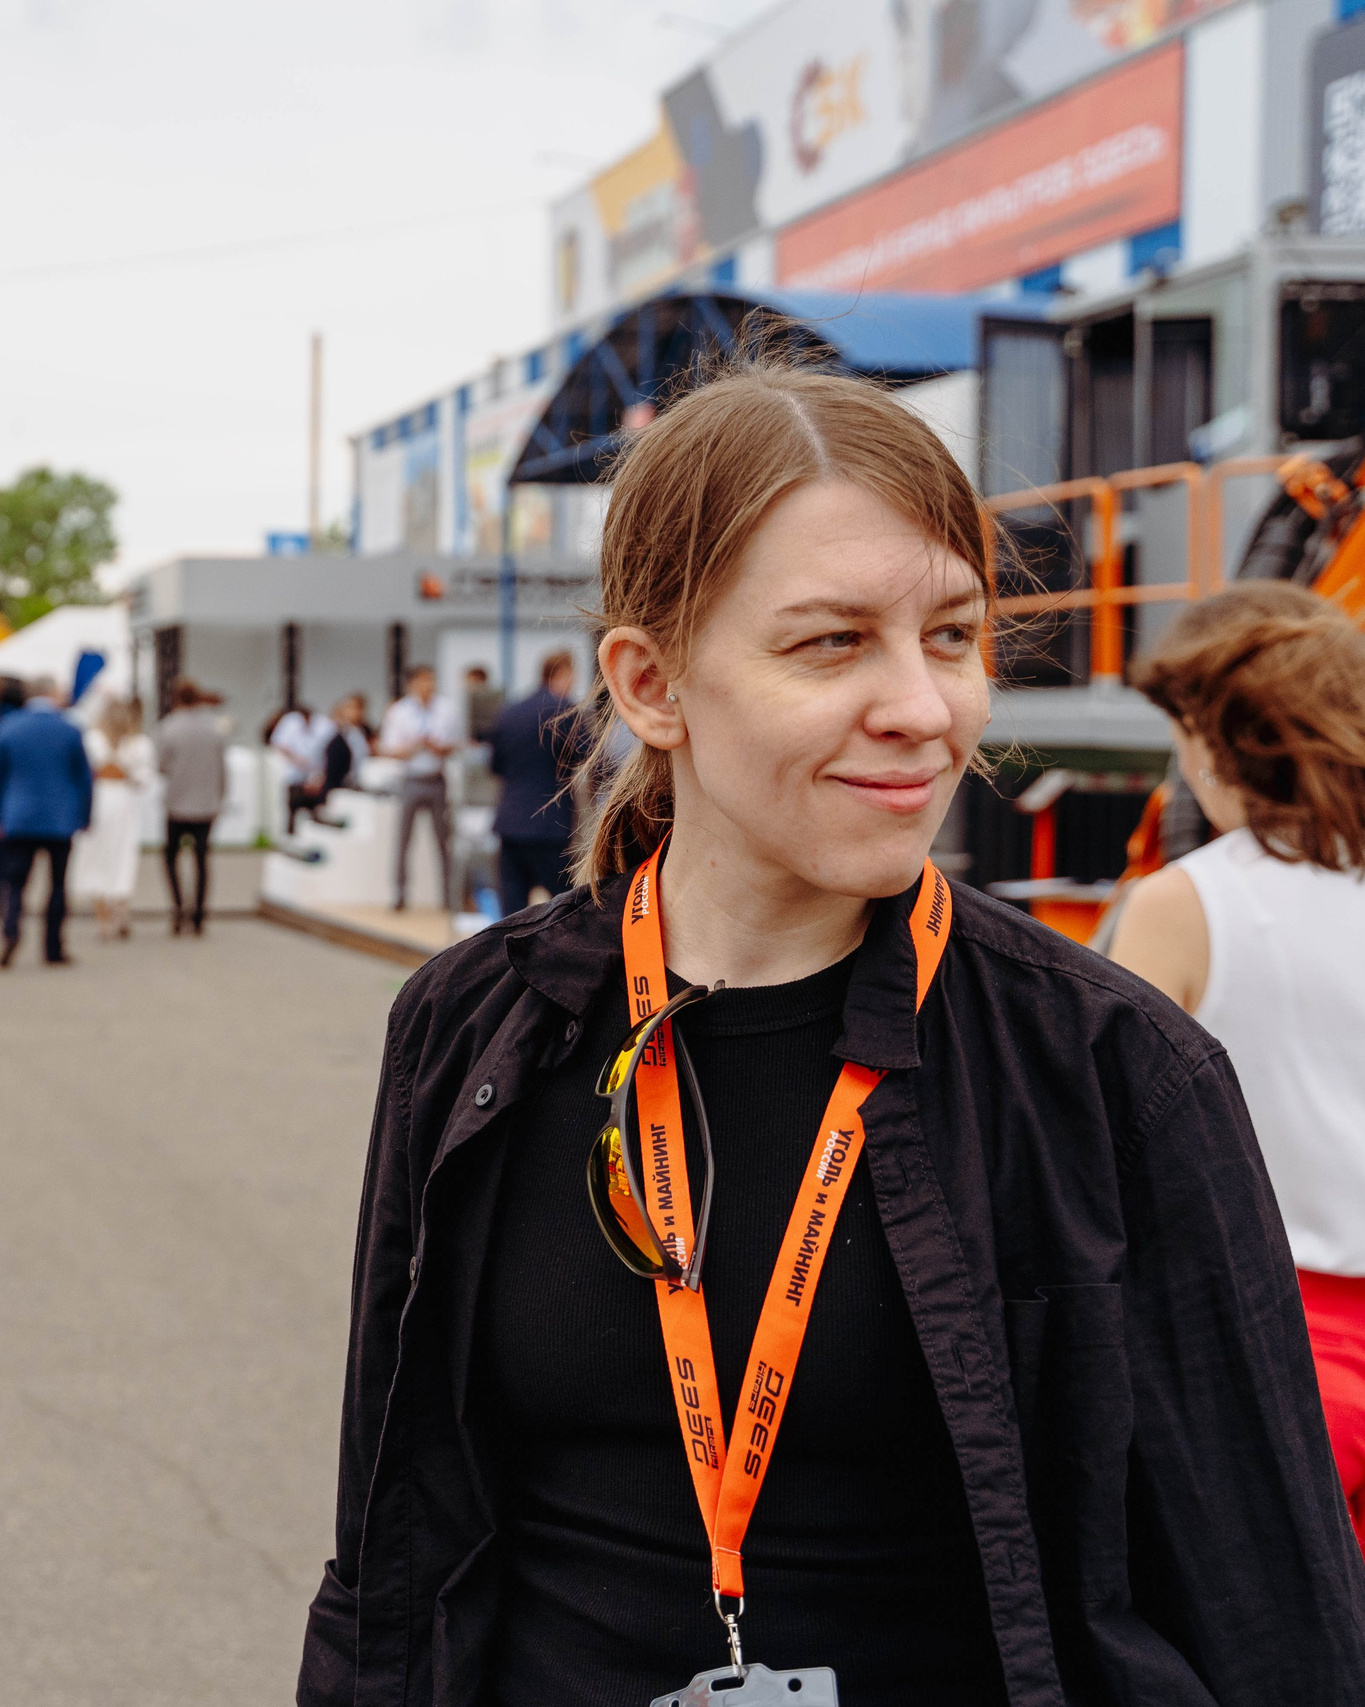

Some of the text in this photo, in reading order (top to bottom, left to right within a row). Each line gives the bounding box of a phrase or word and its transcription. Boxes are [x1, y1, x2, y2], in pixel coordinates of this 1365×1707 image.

[641, 875, 650, 915] РОССИИ
[925, 872, 947, 938] МАЙНИНГ
[650, 1122, 674, 1210] МАЙНИНГ
[815, 1130, 839, 1181] РОССИИ
[664, 1215, 675, 1227] и
[785, 1129, 855, 1307] УГОЛЬ и МАЙНИНГ
[675, 1356, 709, 1467] DEES
[744, 1367, 785, 1480] DEES
